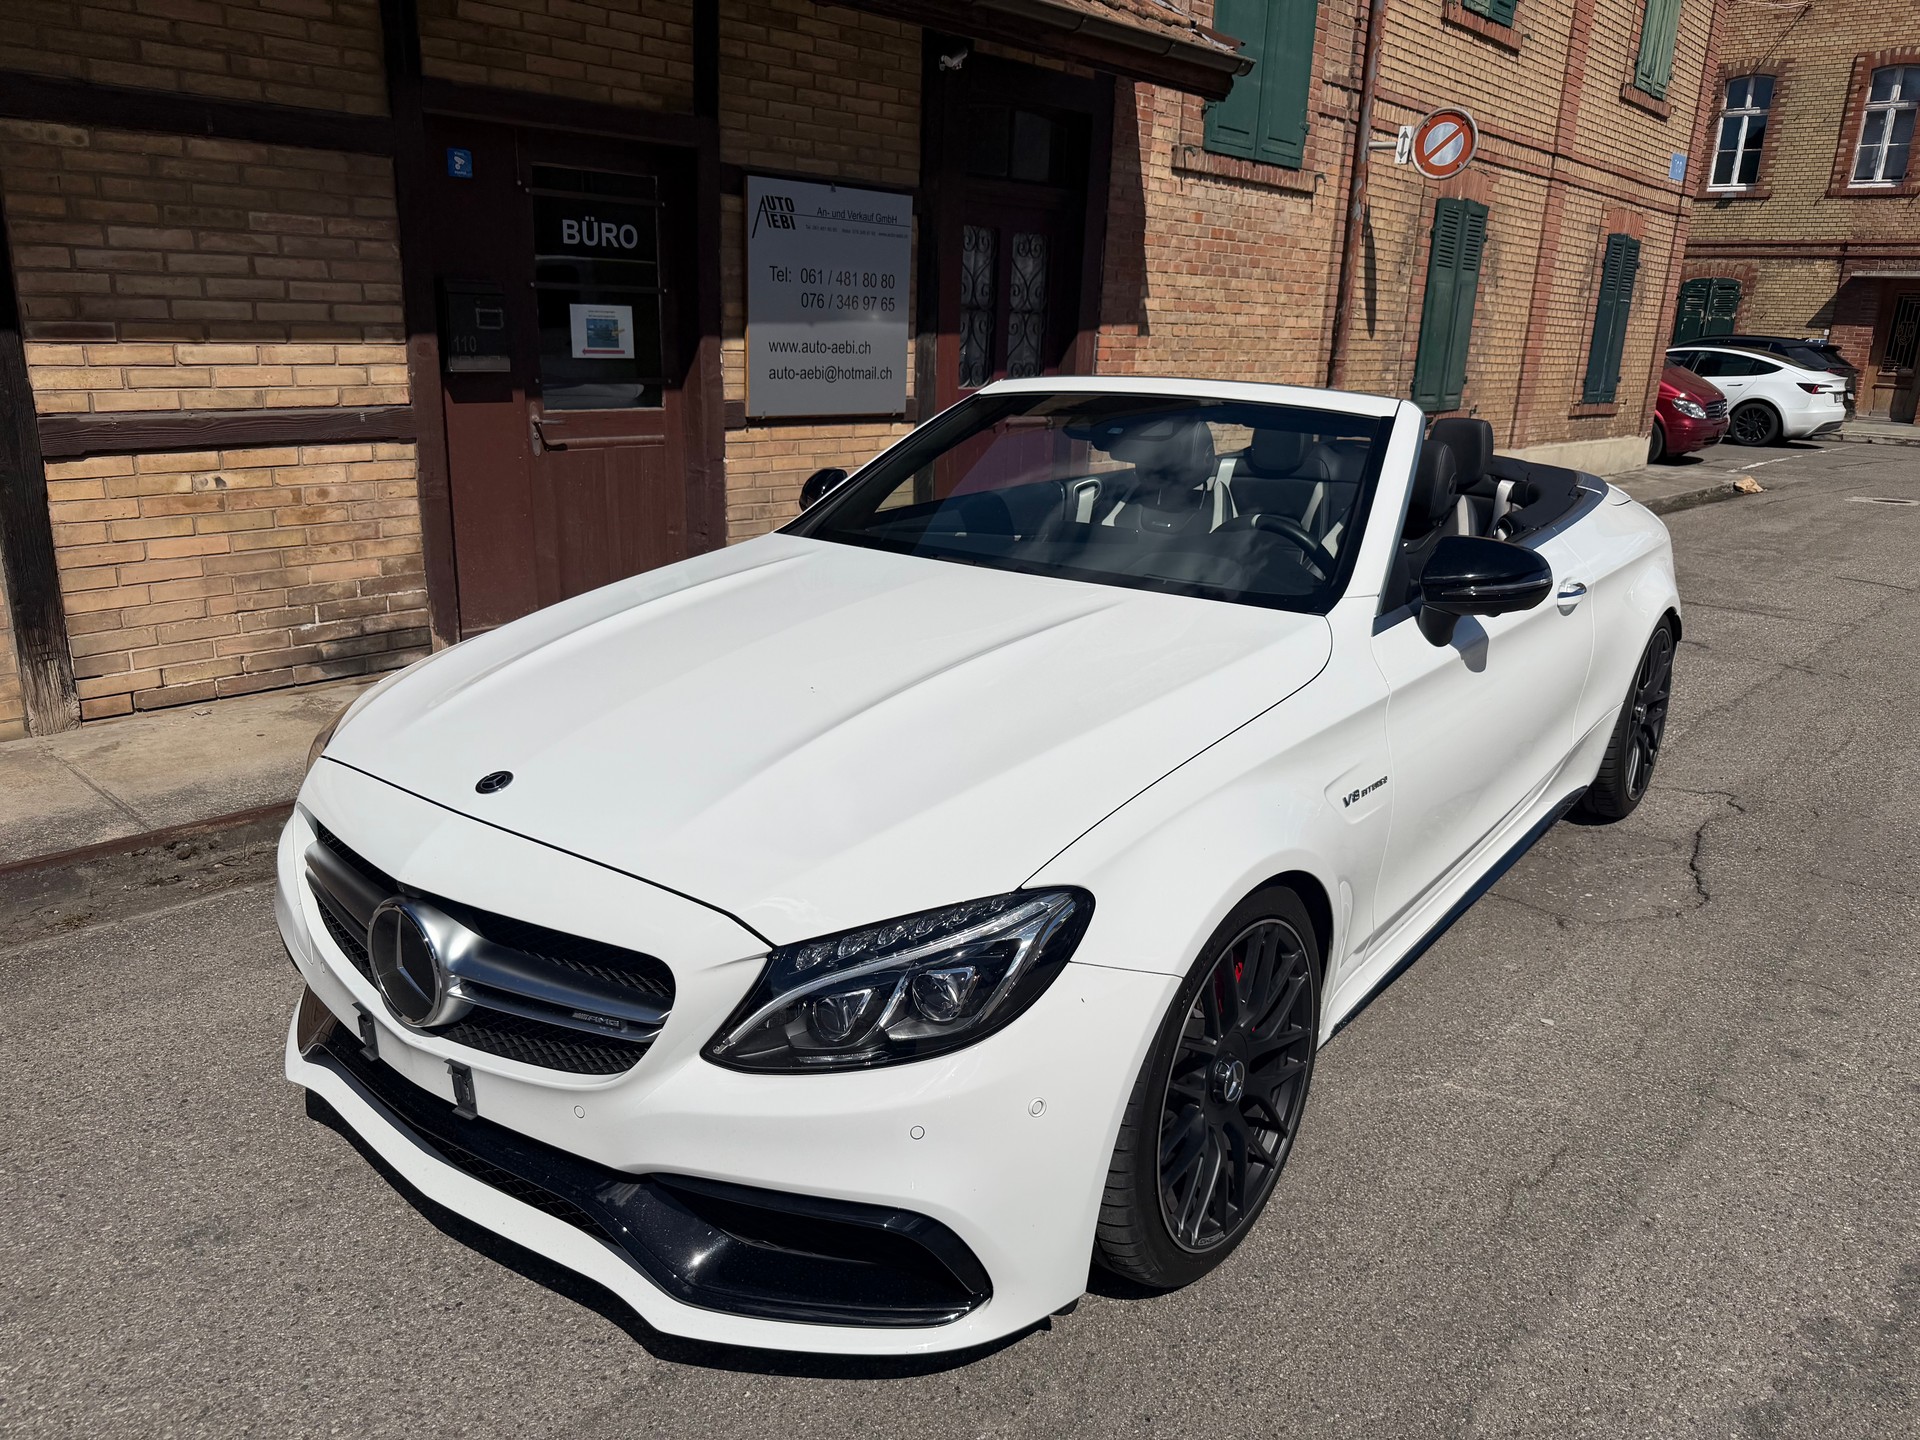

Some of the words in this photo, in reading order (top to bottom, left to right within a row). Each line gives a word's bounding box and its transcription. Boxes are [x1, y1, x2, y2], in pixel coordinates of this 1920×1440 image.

[757, 195, 795, 213] AUTO
[816, 207, 831, 217] An-
[831, 209, 846, 219] und
[847, 210, 875, 222] Verkauf
[875, 213, 898, 225] GmbH
[562, 216, 638, 249] BÜRO
[769, 265, 792, 283] Tel:
[800, 267, 824, 285] 061
[827, 270, 833, 286] /
[836, 271, 858, 287] 481
[862, 272, 877, 288] 80
[880, 273, 895, 289] 80
[801, 292, 825, 309] 076
[828, 294, 834, 309] /
[836, 294, 859, 311] 346
[862, 296, 877, 311] 97
[880, 297, 895, 312] 65
[453, 335, 477, 353] 110
[768, 340, 871, 356] www.auto-aebi.ch
[768, 365, 893, 383] auto-aebi@hotmail.ch
[1342, 788, 1361, 808] V8
